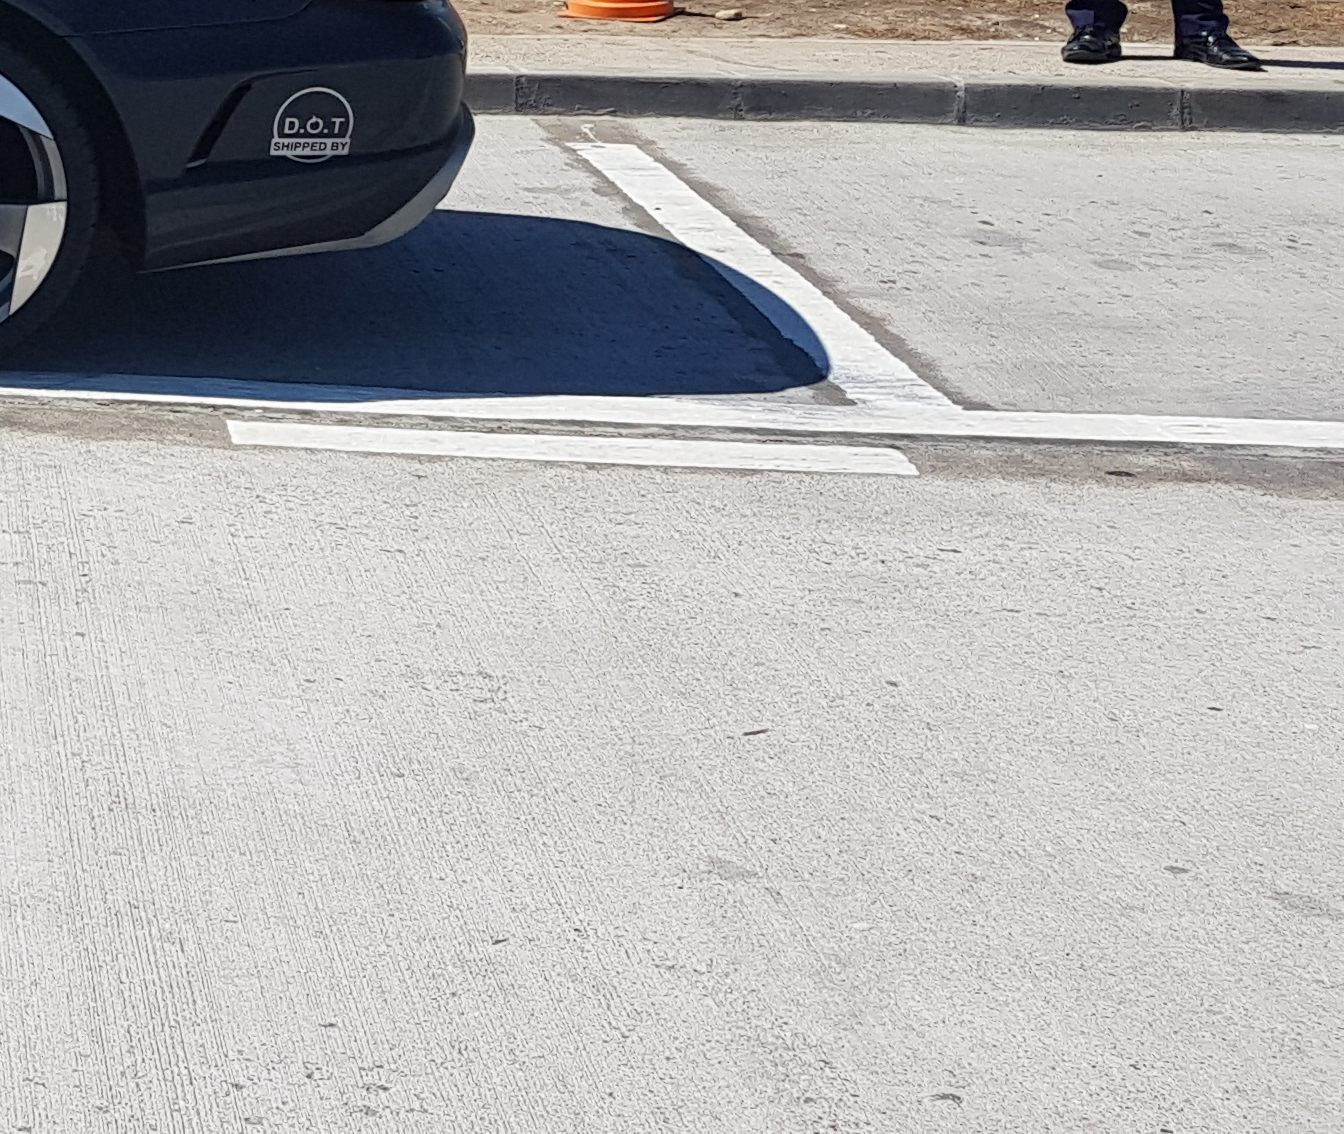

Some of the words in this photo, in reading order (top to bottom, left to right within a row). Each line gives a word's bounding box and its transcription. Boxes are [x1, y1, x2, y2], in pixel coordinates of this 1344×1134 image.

[284, 115, 346, 134] D.O.T
[273, 141, 327, 152] SHIPPED
[330, 141, 348, 152] BY
